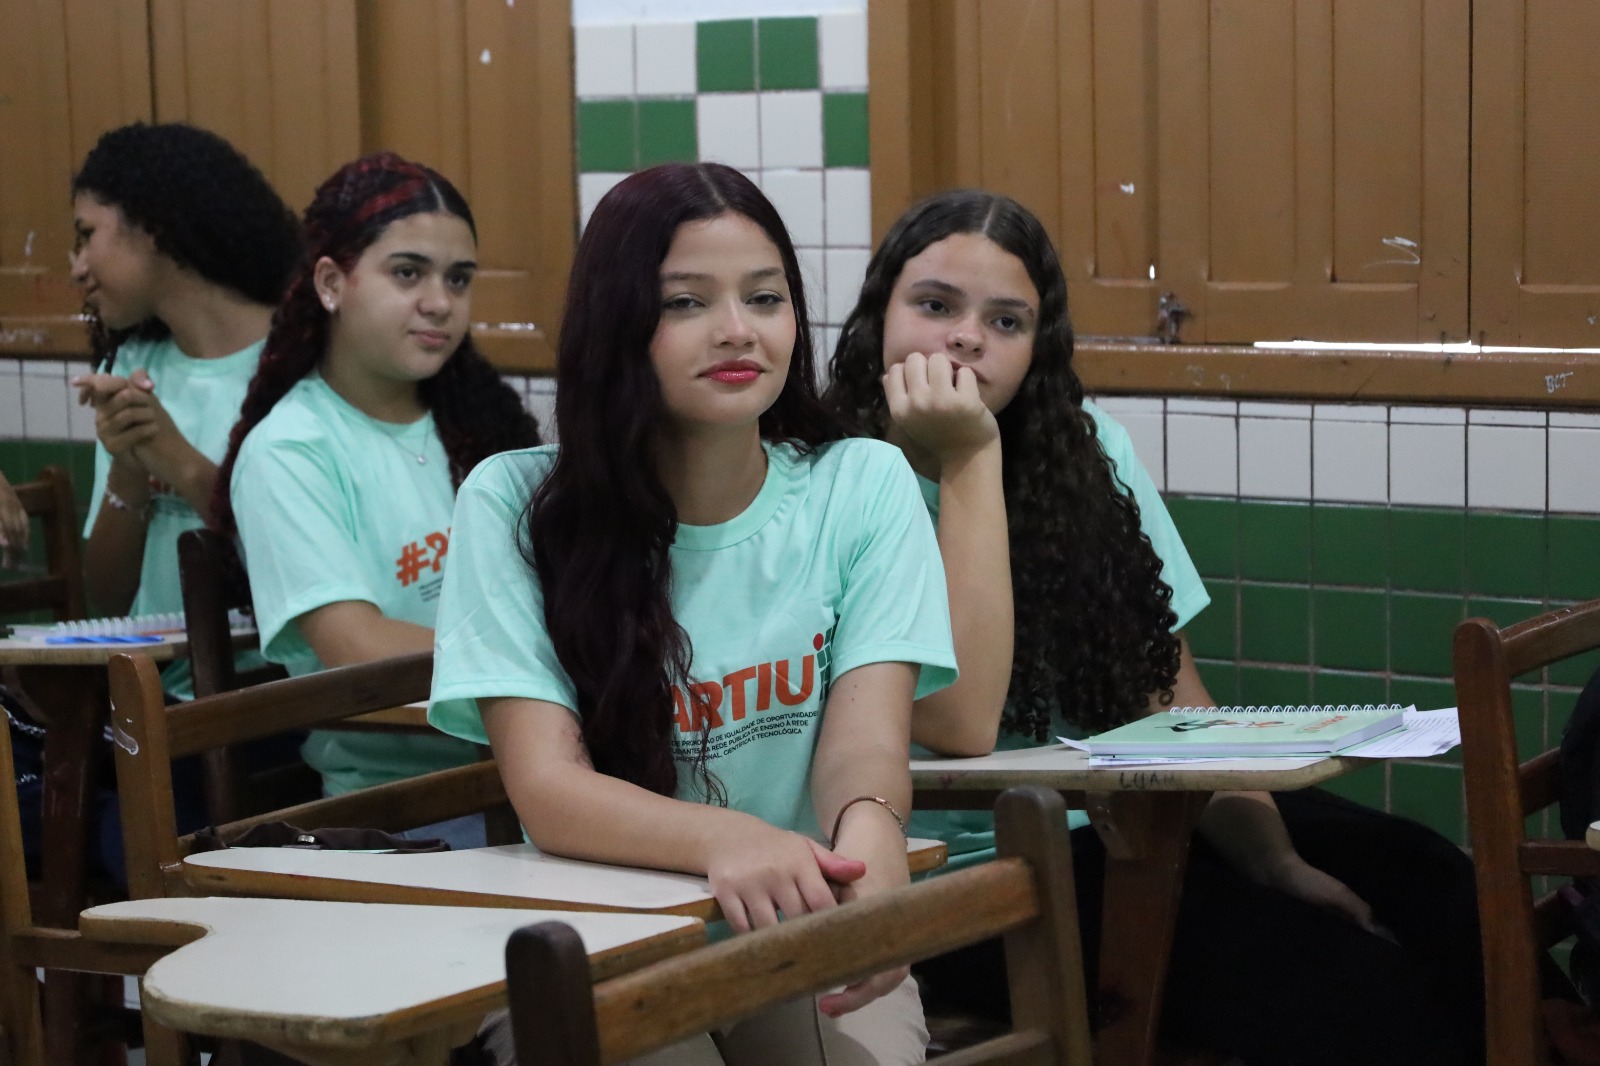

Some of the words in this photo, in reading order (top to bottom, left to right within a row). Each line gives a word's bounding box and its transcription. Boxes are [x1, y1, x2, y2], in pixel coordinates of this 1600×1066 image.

[712, 742, 728, 751] REDE
[751, 726, 759, 734] DE
[760, 722, 785, 731] ENSINO
[715, 733, 724, 741] DE
[724, 721, 755, 739] IGUALDADE
